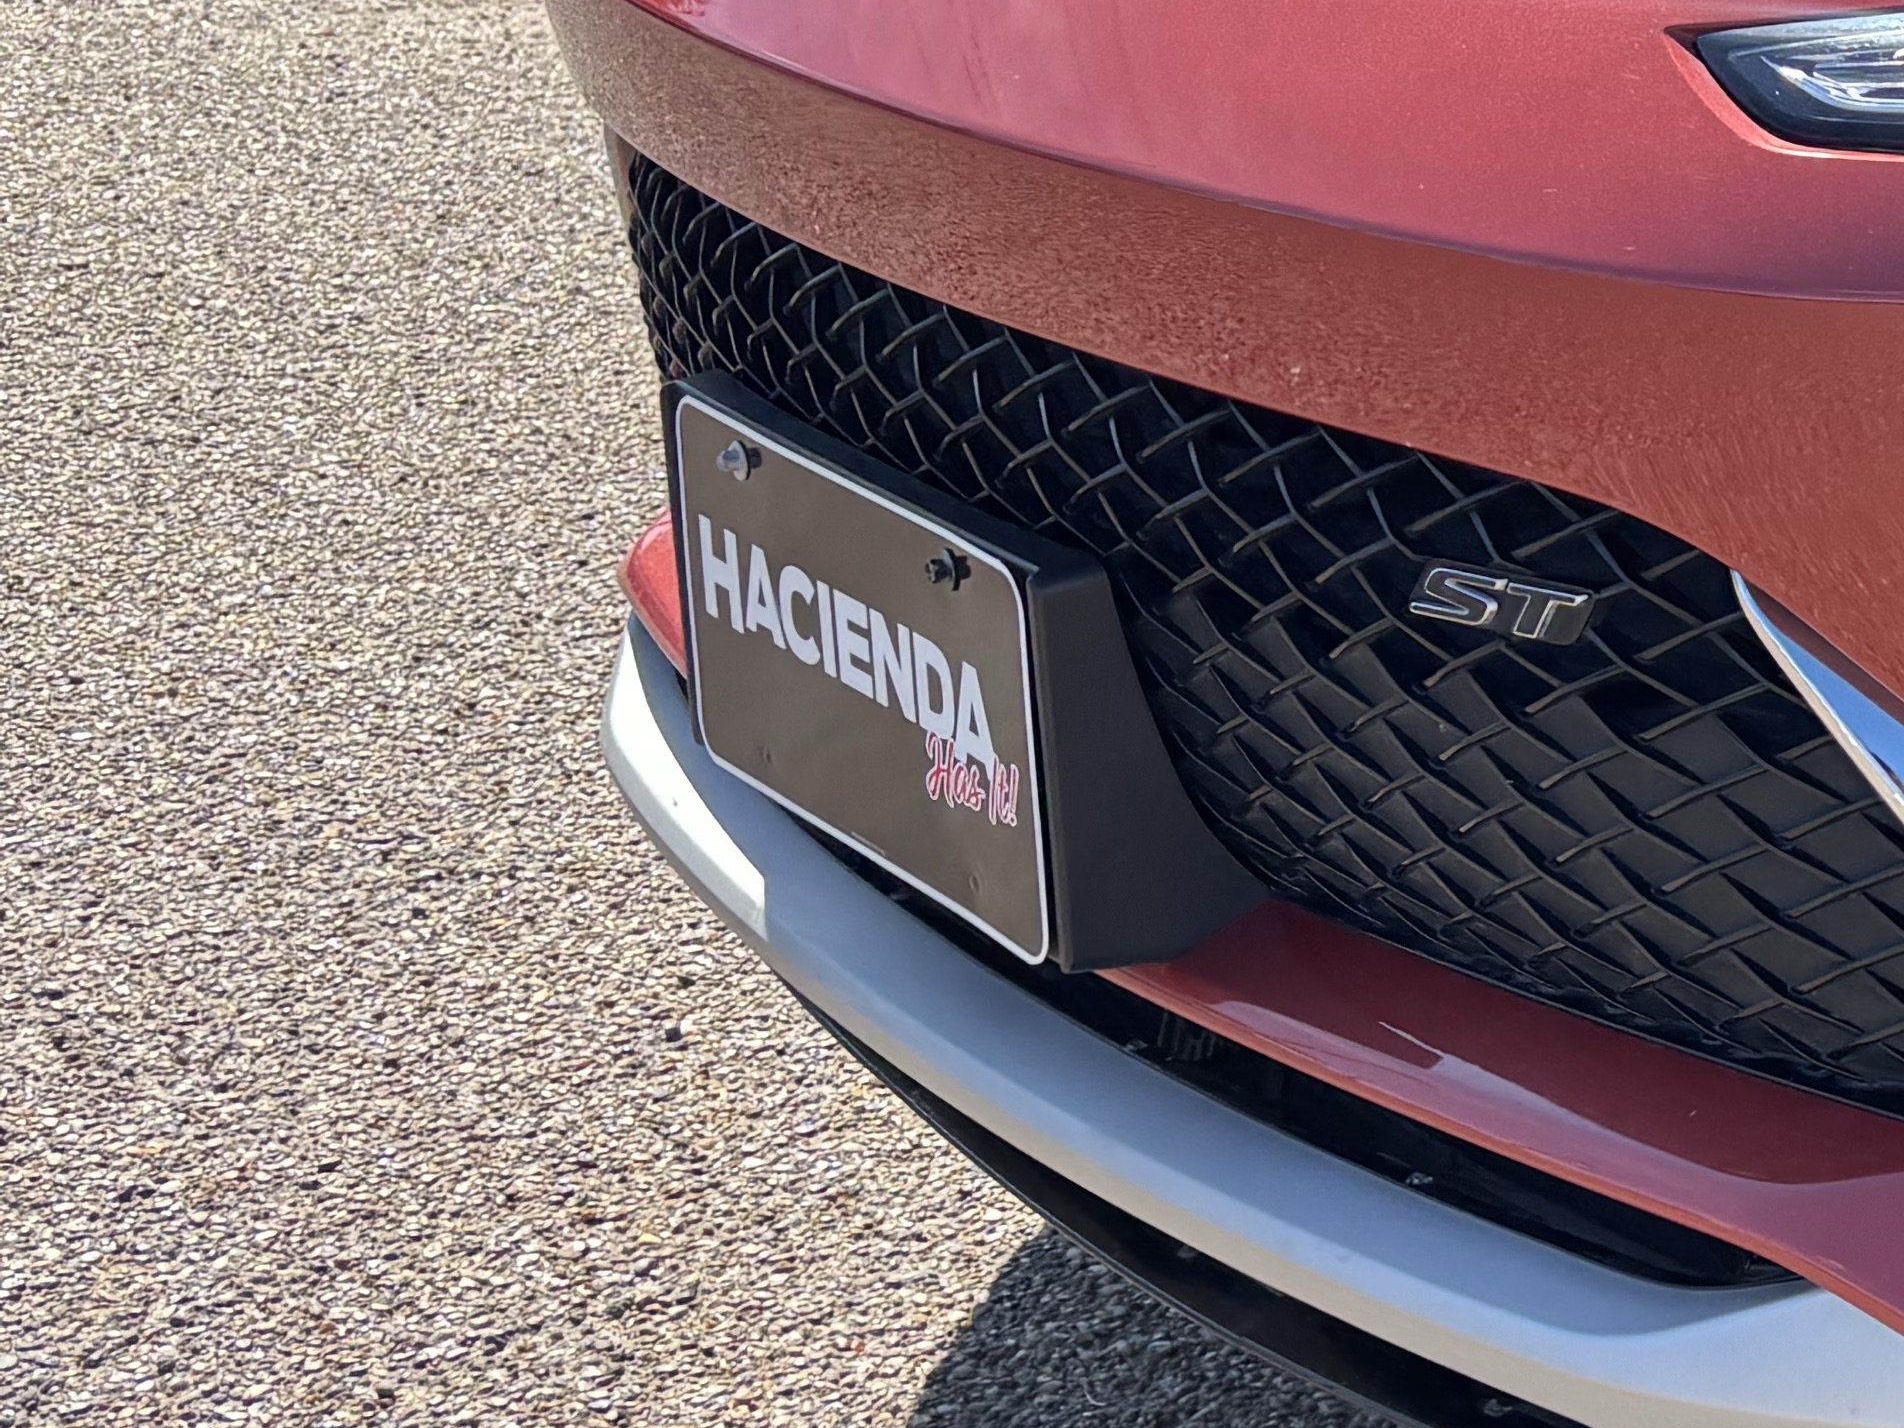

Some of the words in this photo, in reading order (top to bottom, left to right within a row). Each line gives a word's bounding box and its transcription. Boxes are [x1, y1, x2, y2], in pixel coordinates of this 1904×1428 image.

[697, 513, 995, 781] HACIENDA
[1409, 567, 1589, 639] ST
[926, 731, 987, 812] Has
[989, 753, 1020, 827] It!
